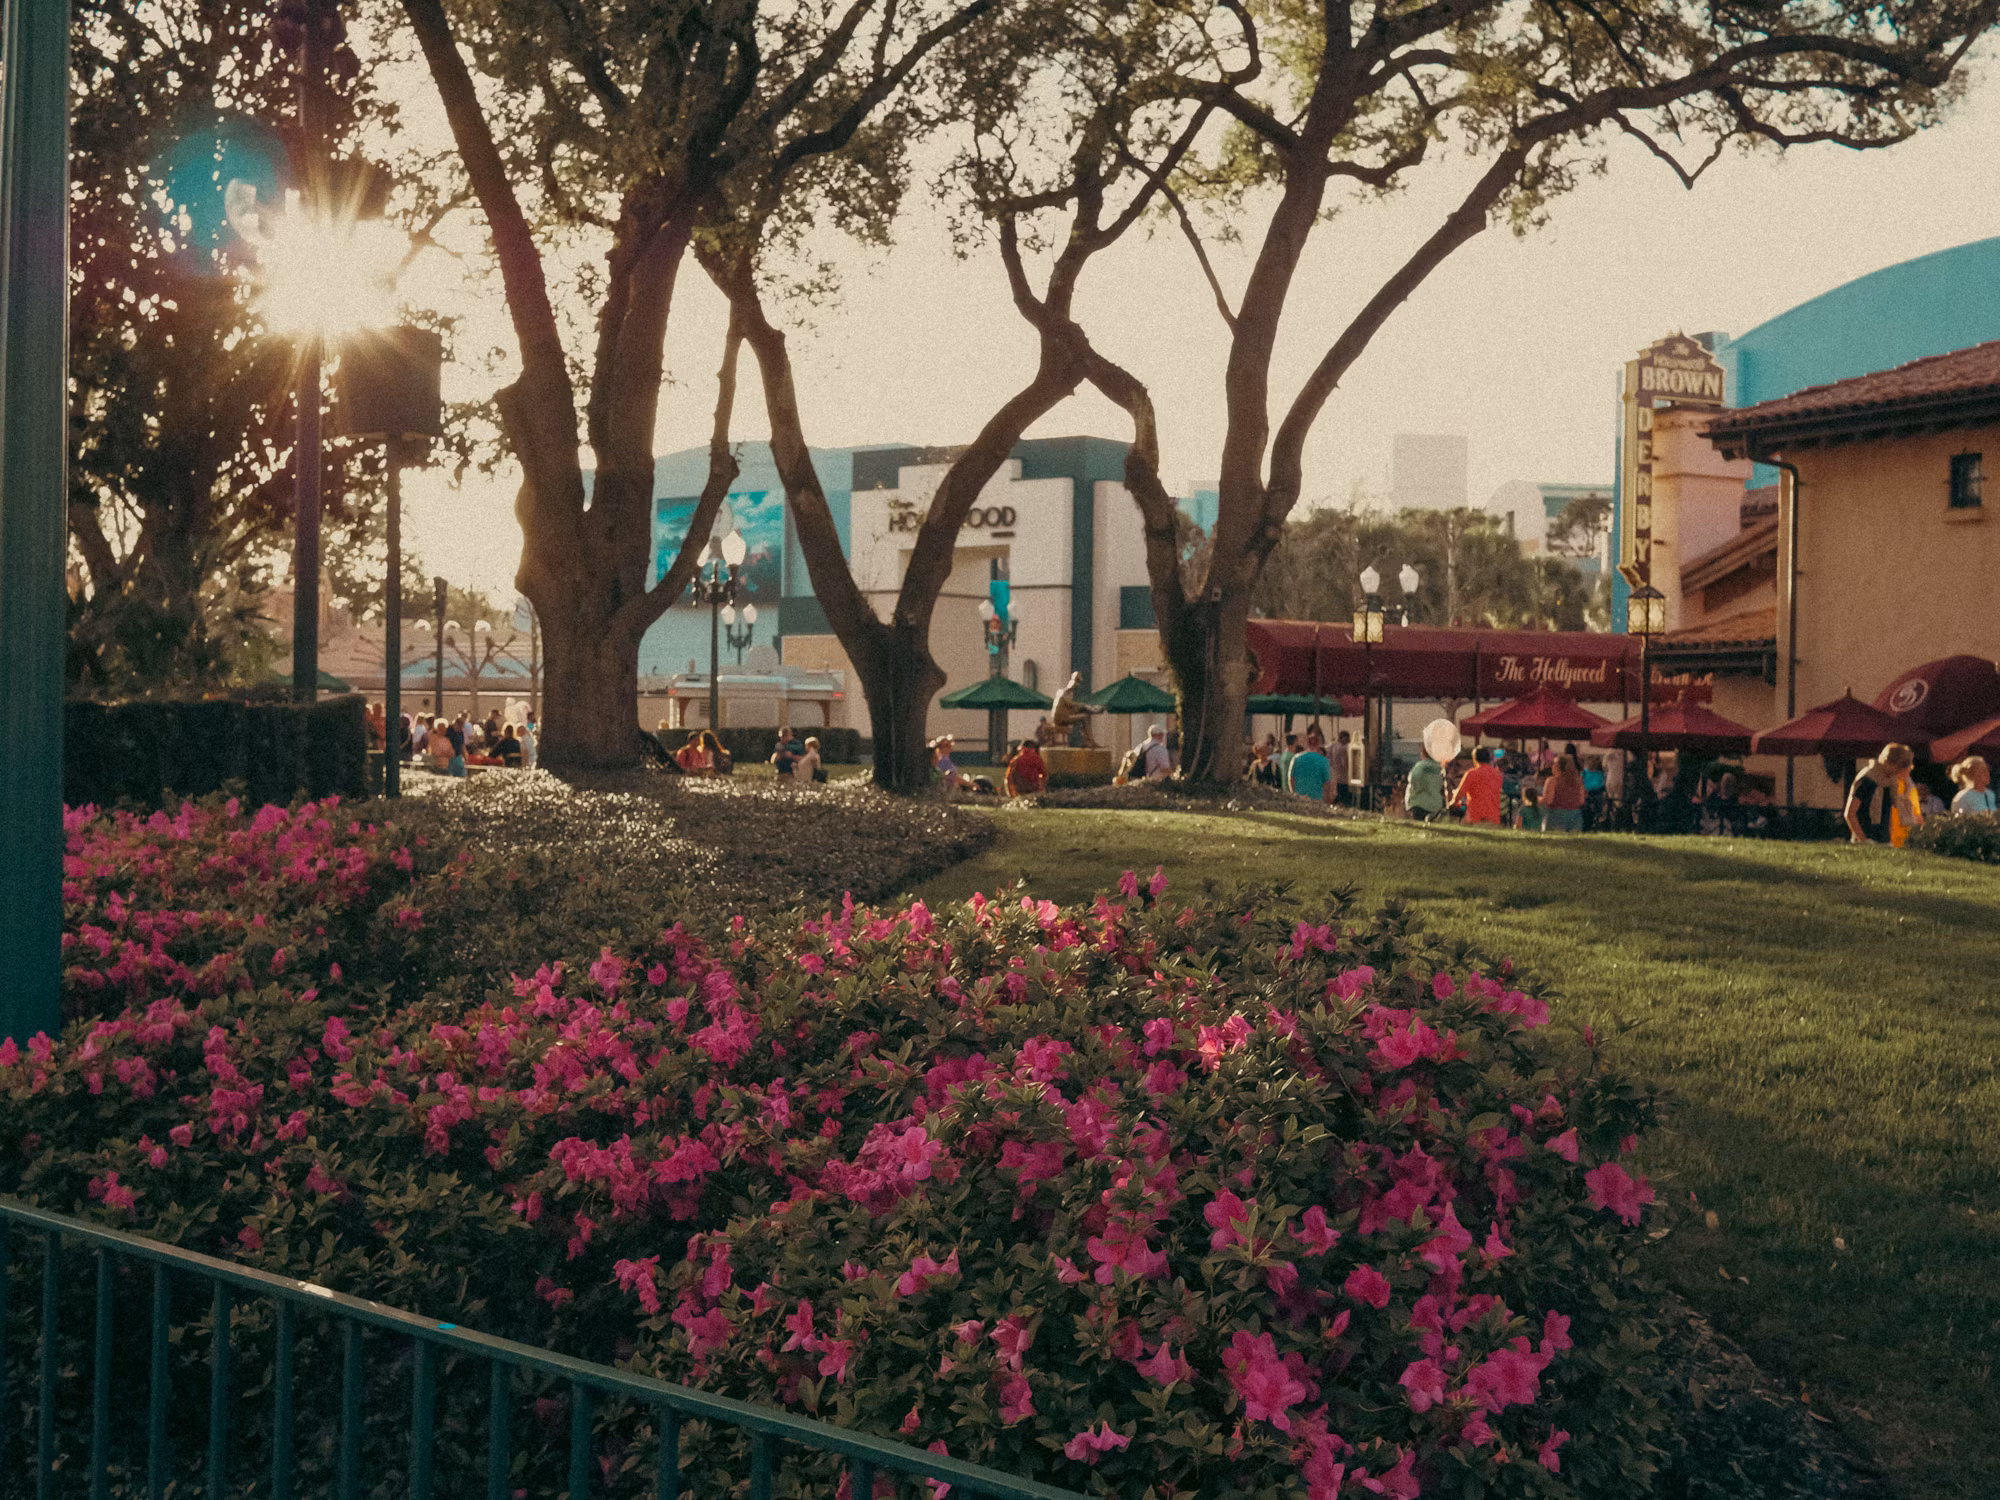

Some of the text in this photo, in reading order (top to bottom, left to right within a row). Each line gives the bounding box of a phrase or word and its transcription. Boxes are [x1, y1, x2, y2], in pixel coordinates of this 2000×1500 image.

[1641, 366, 1720, 397] BROWN
[1636, 407, 1653, 562] DERBY
[888, 506, 1016, 532] HOOOD
[1495, 656, 1525, 682] The
[1530, 656, 1607, 689] Hollywood
